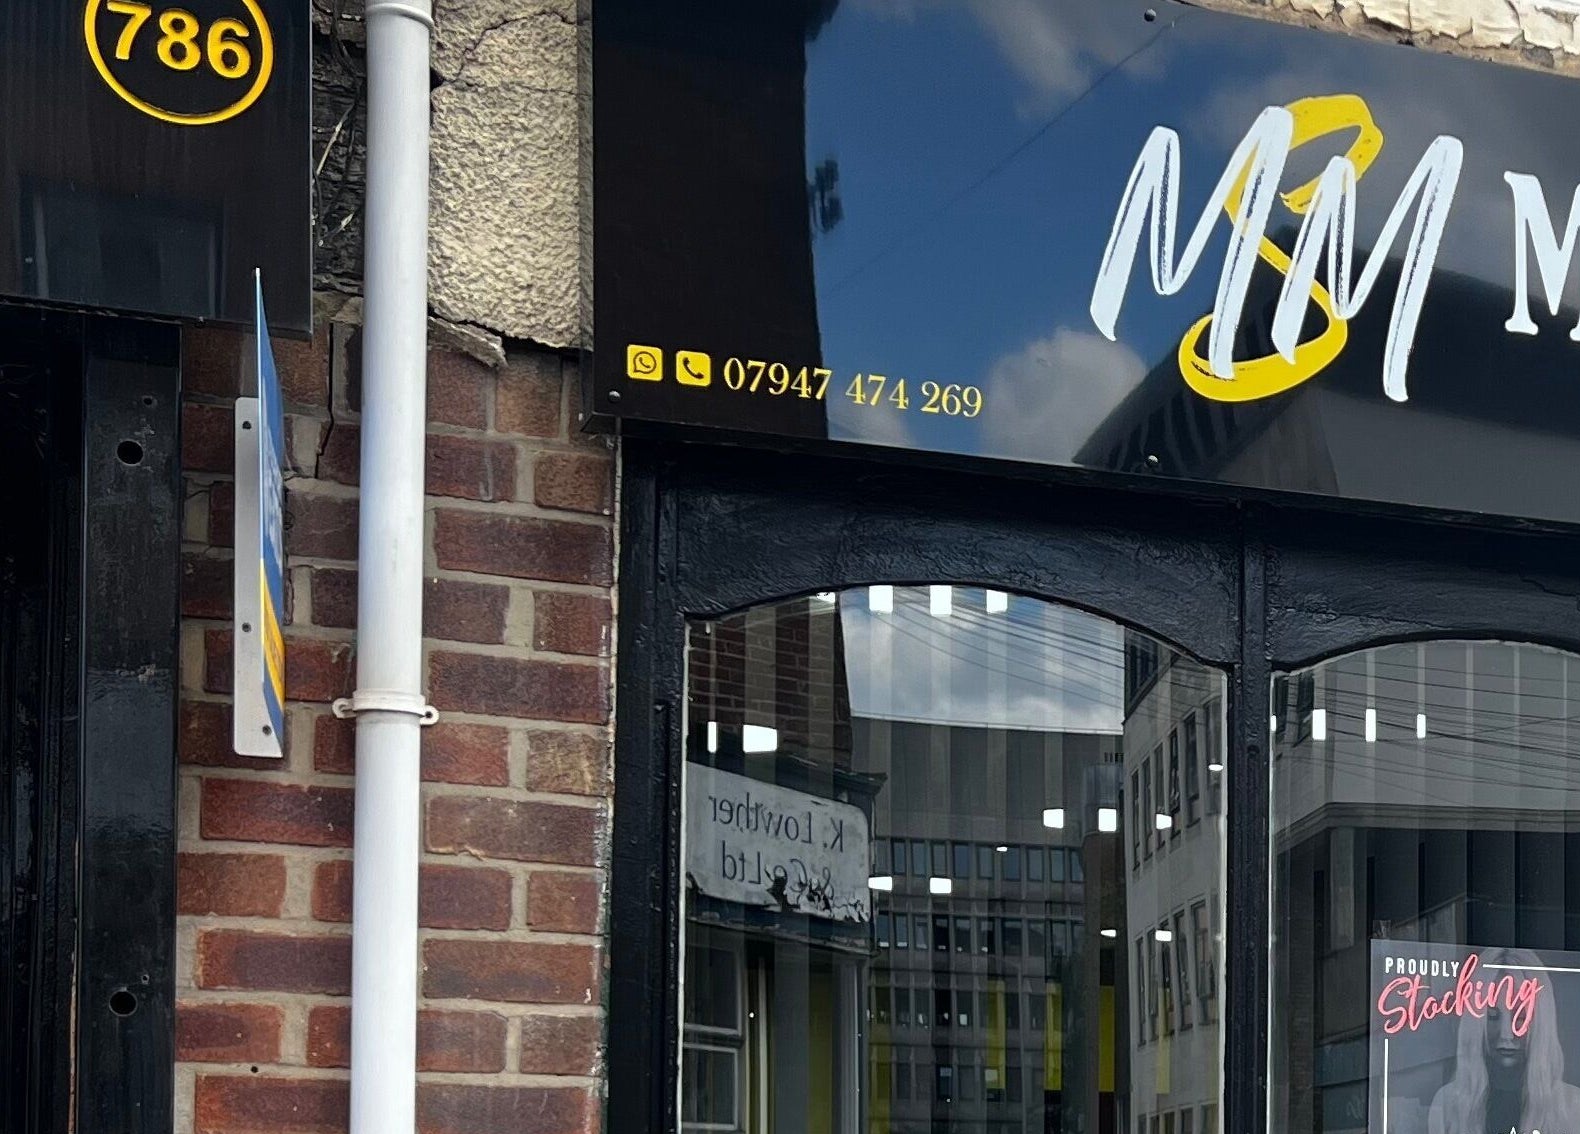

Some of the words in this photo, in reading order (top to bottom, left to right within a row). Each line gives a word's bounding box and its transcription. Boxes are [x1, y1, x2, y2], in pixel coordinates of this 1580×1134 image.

[106, 1, 251, 79] 786
[723, 357, 832, 401] 07947
[845, 373, 909, 410] 474
[920, 381, 983, 418] 269
[1377, 953, 1545, 1038] Stocking
[1385, 957, 1460, 978] PROUDLY
